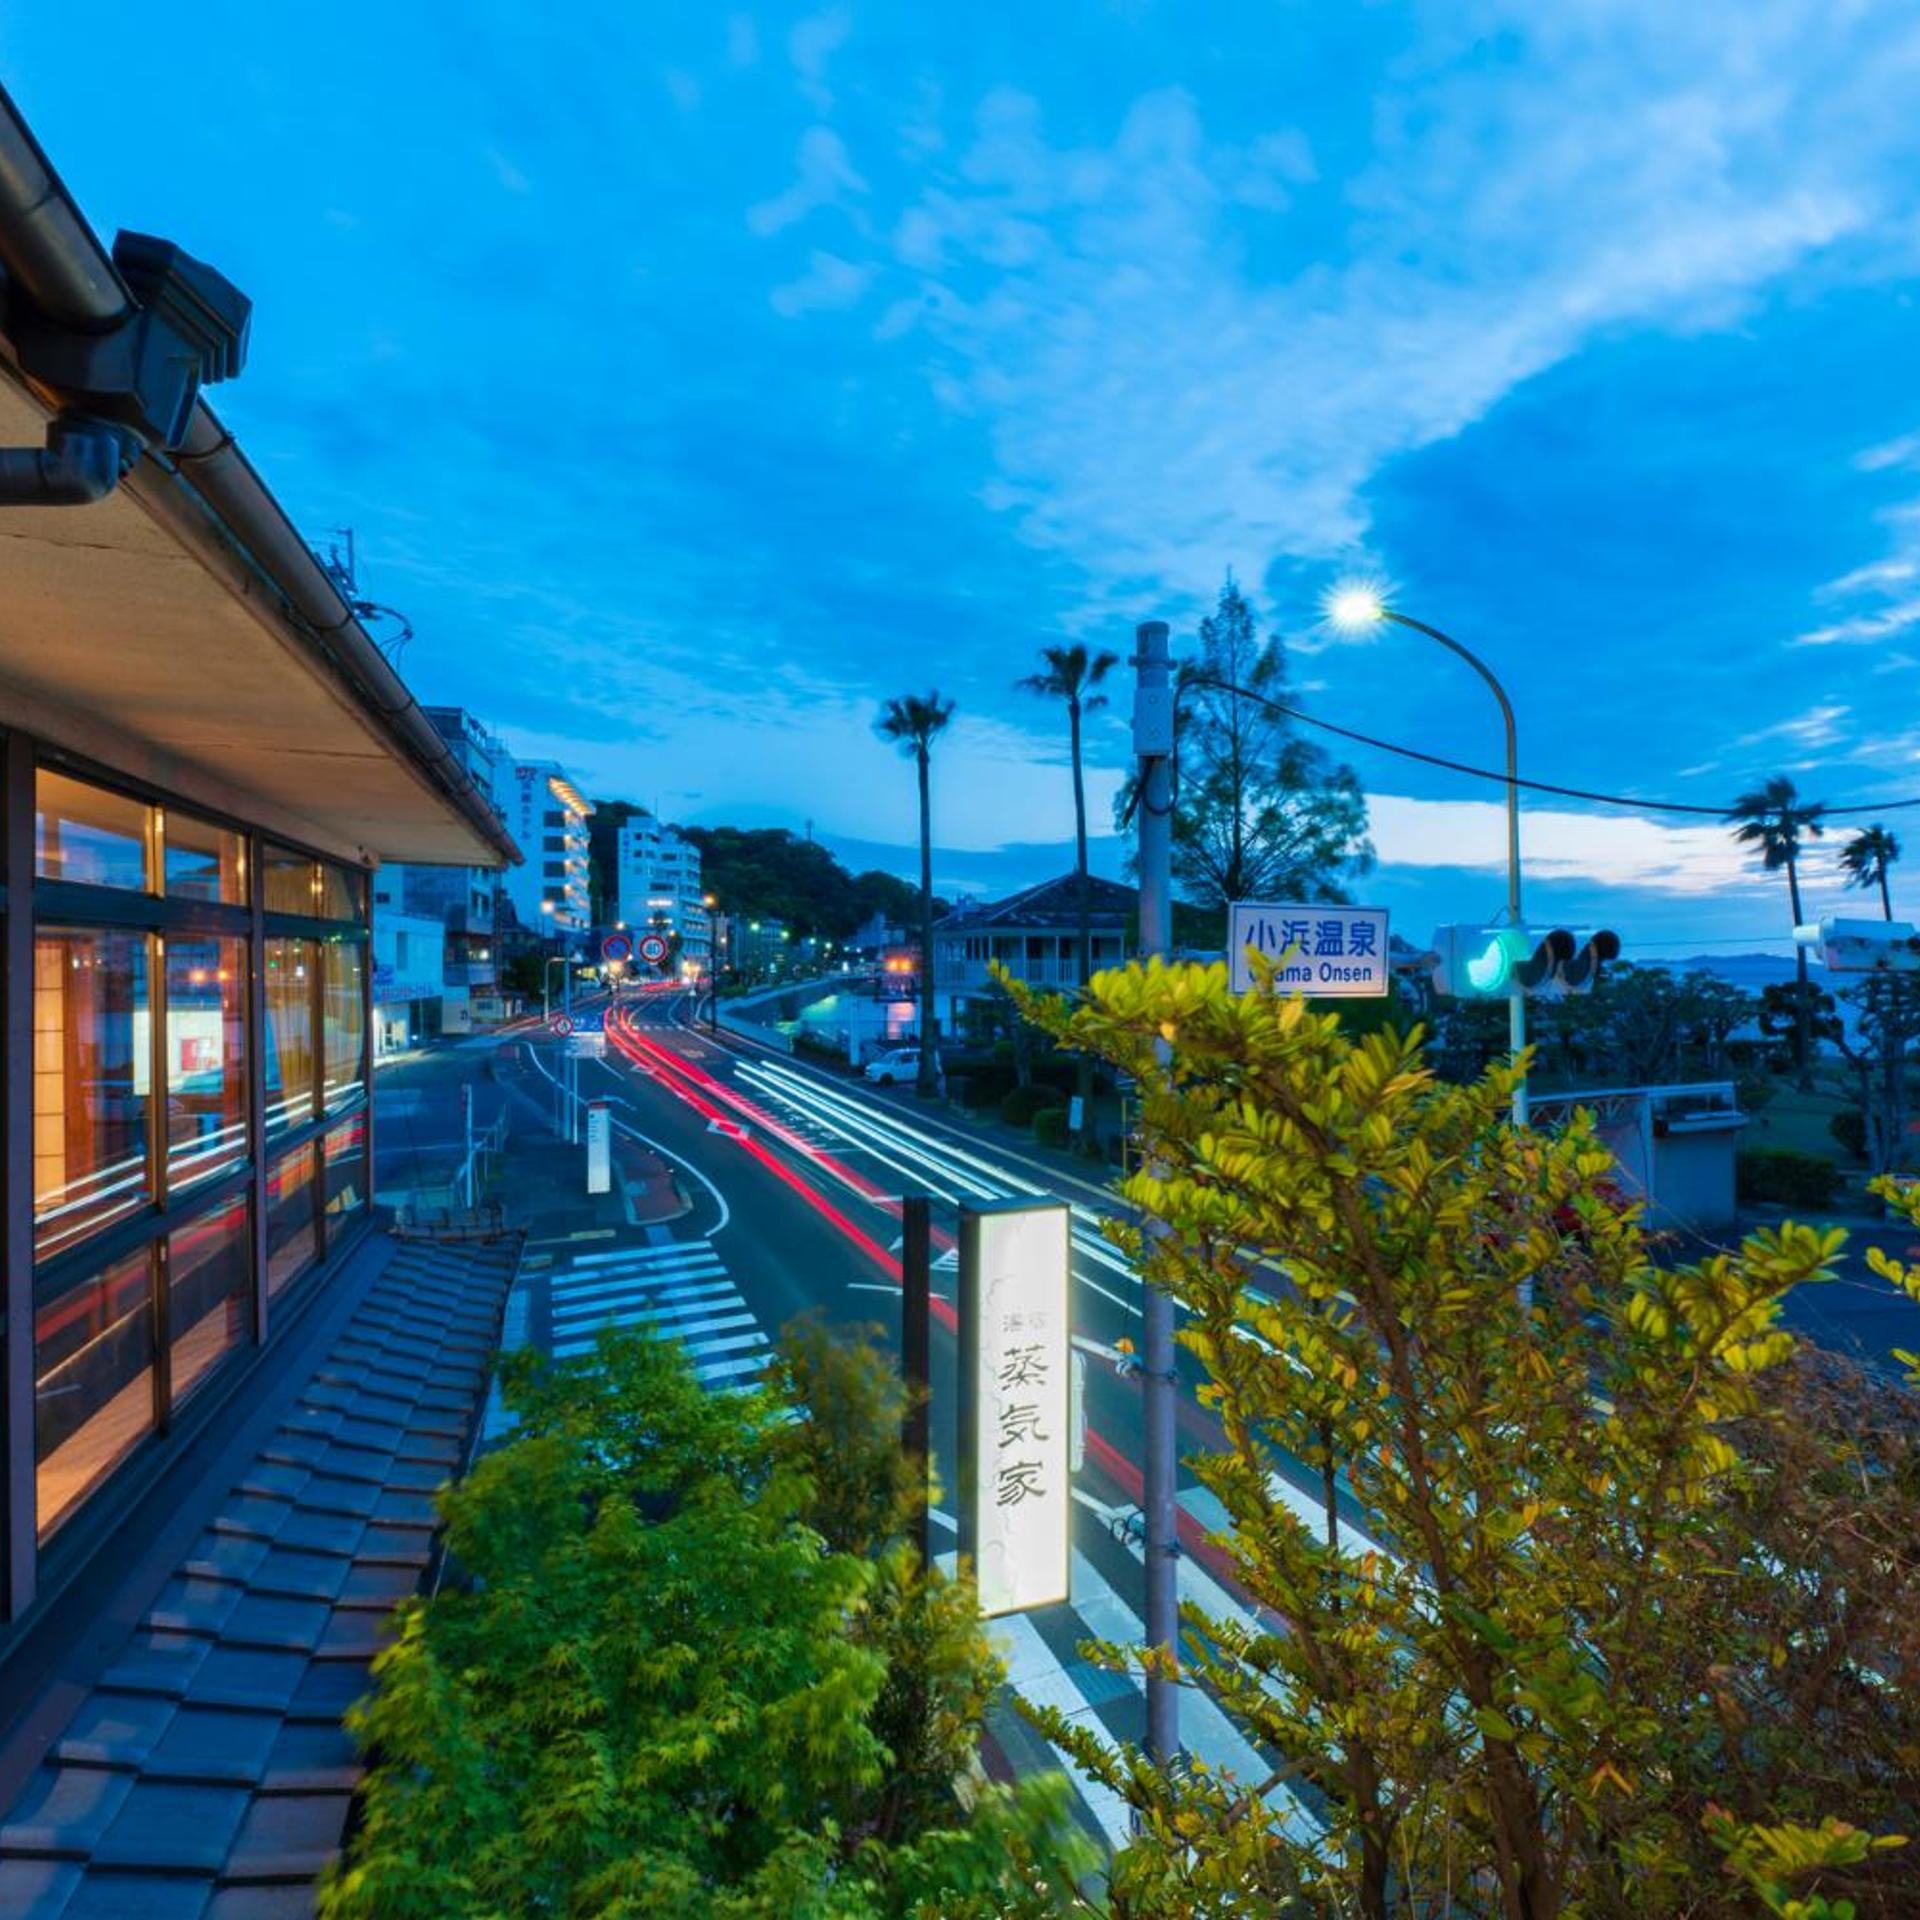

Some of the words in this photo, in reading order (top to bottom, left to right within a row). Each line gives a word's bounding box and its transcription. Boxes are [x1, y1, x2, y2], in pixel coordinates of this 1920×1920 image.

[1246, 919, 1377, 957] 小浜温泉
[1248, 964, 1312, 982] ama
[1320, 962, 1372, 982] Onsen
[997, 1345, 1049, 1507] 蒸気家
